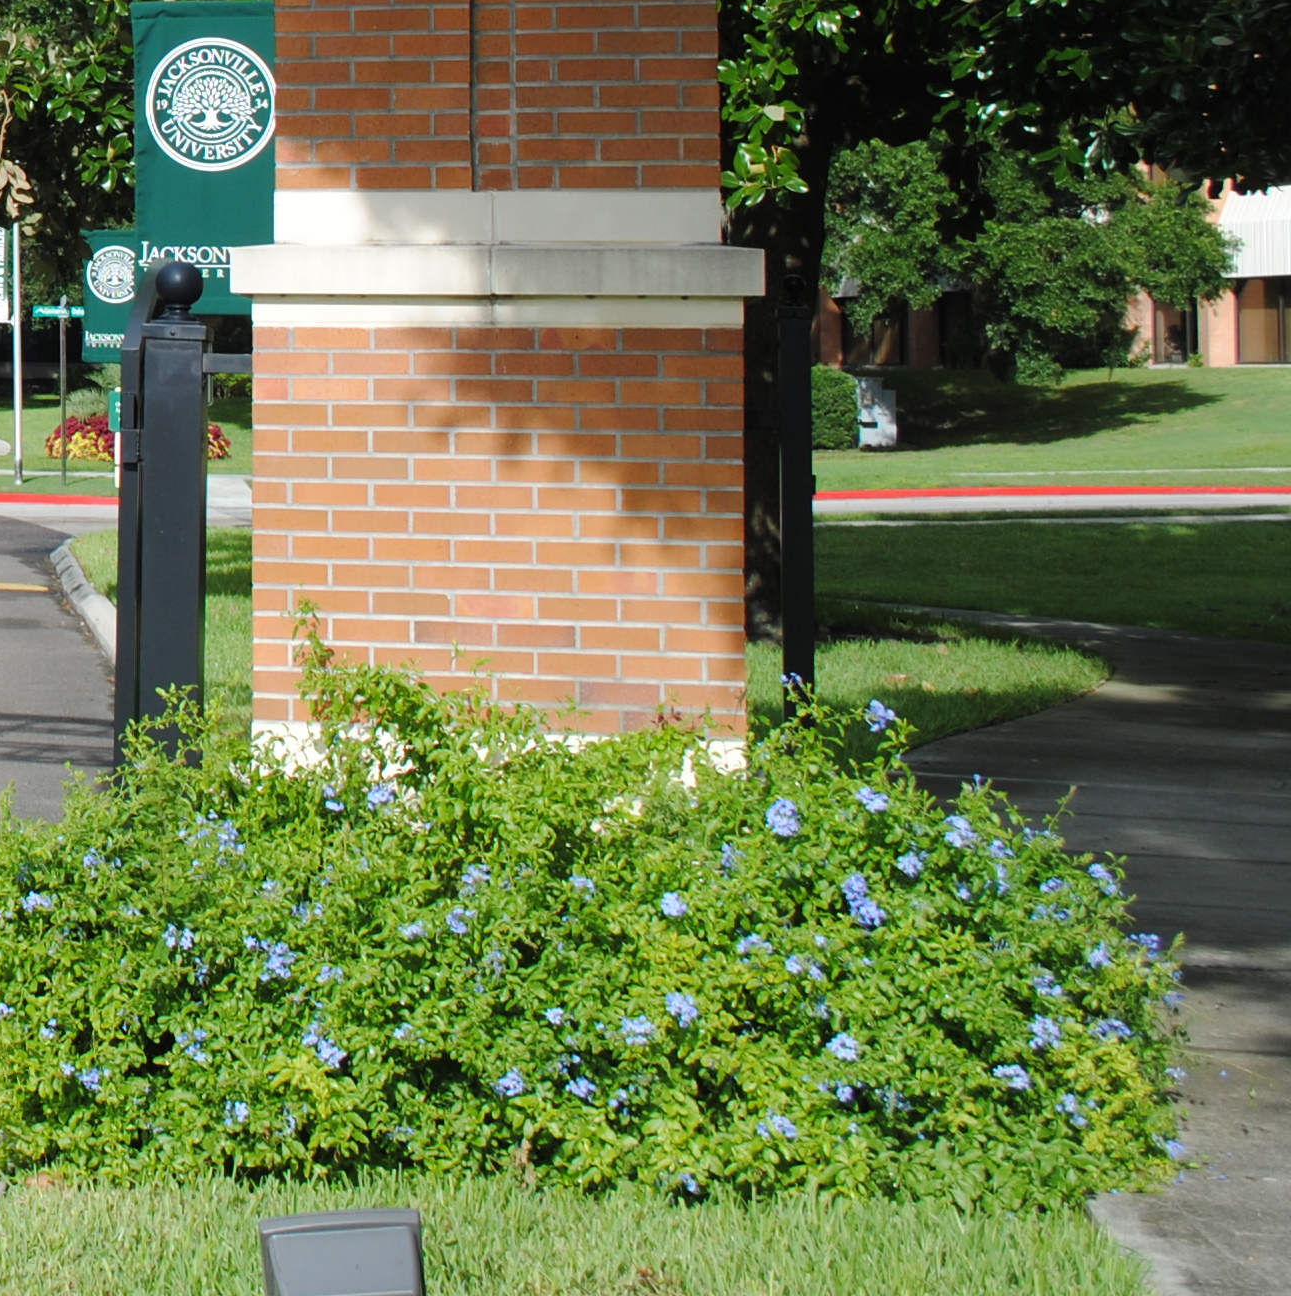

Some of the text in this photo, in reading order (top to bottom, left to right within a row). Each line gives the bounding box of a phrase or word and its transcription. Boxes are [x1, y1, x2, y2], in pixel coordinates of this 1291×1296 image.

[158, 48, 265, 98] JACKSONVILLE
[156, 98, 269, 110] 19 34
[161, 116, 263, 160] UNIVERSITY
[138, 241, 231, 264] JACKSON
